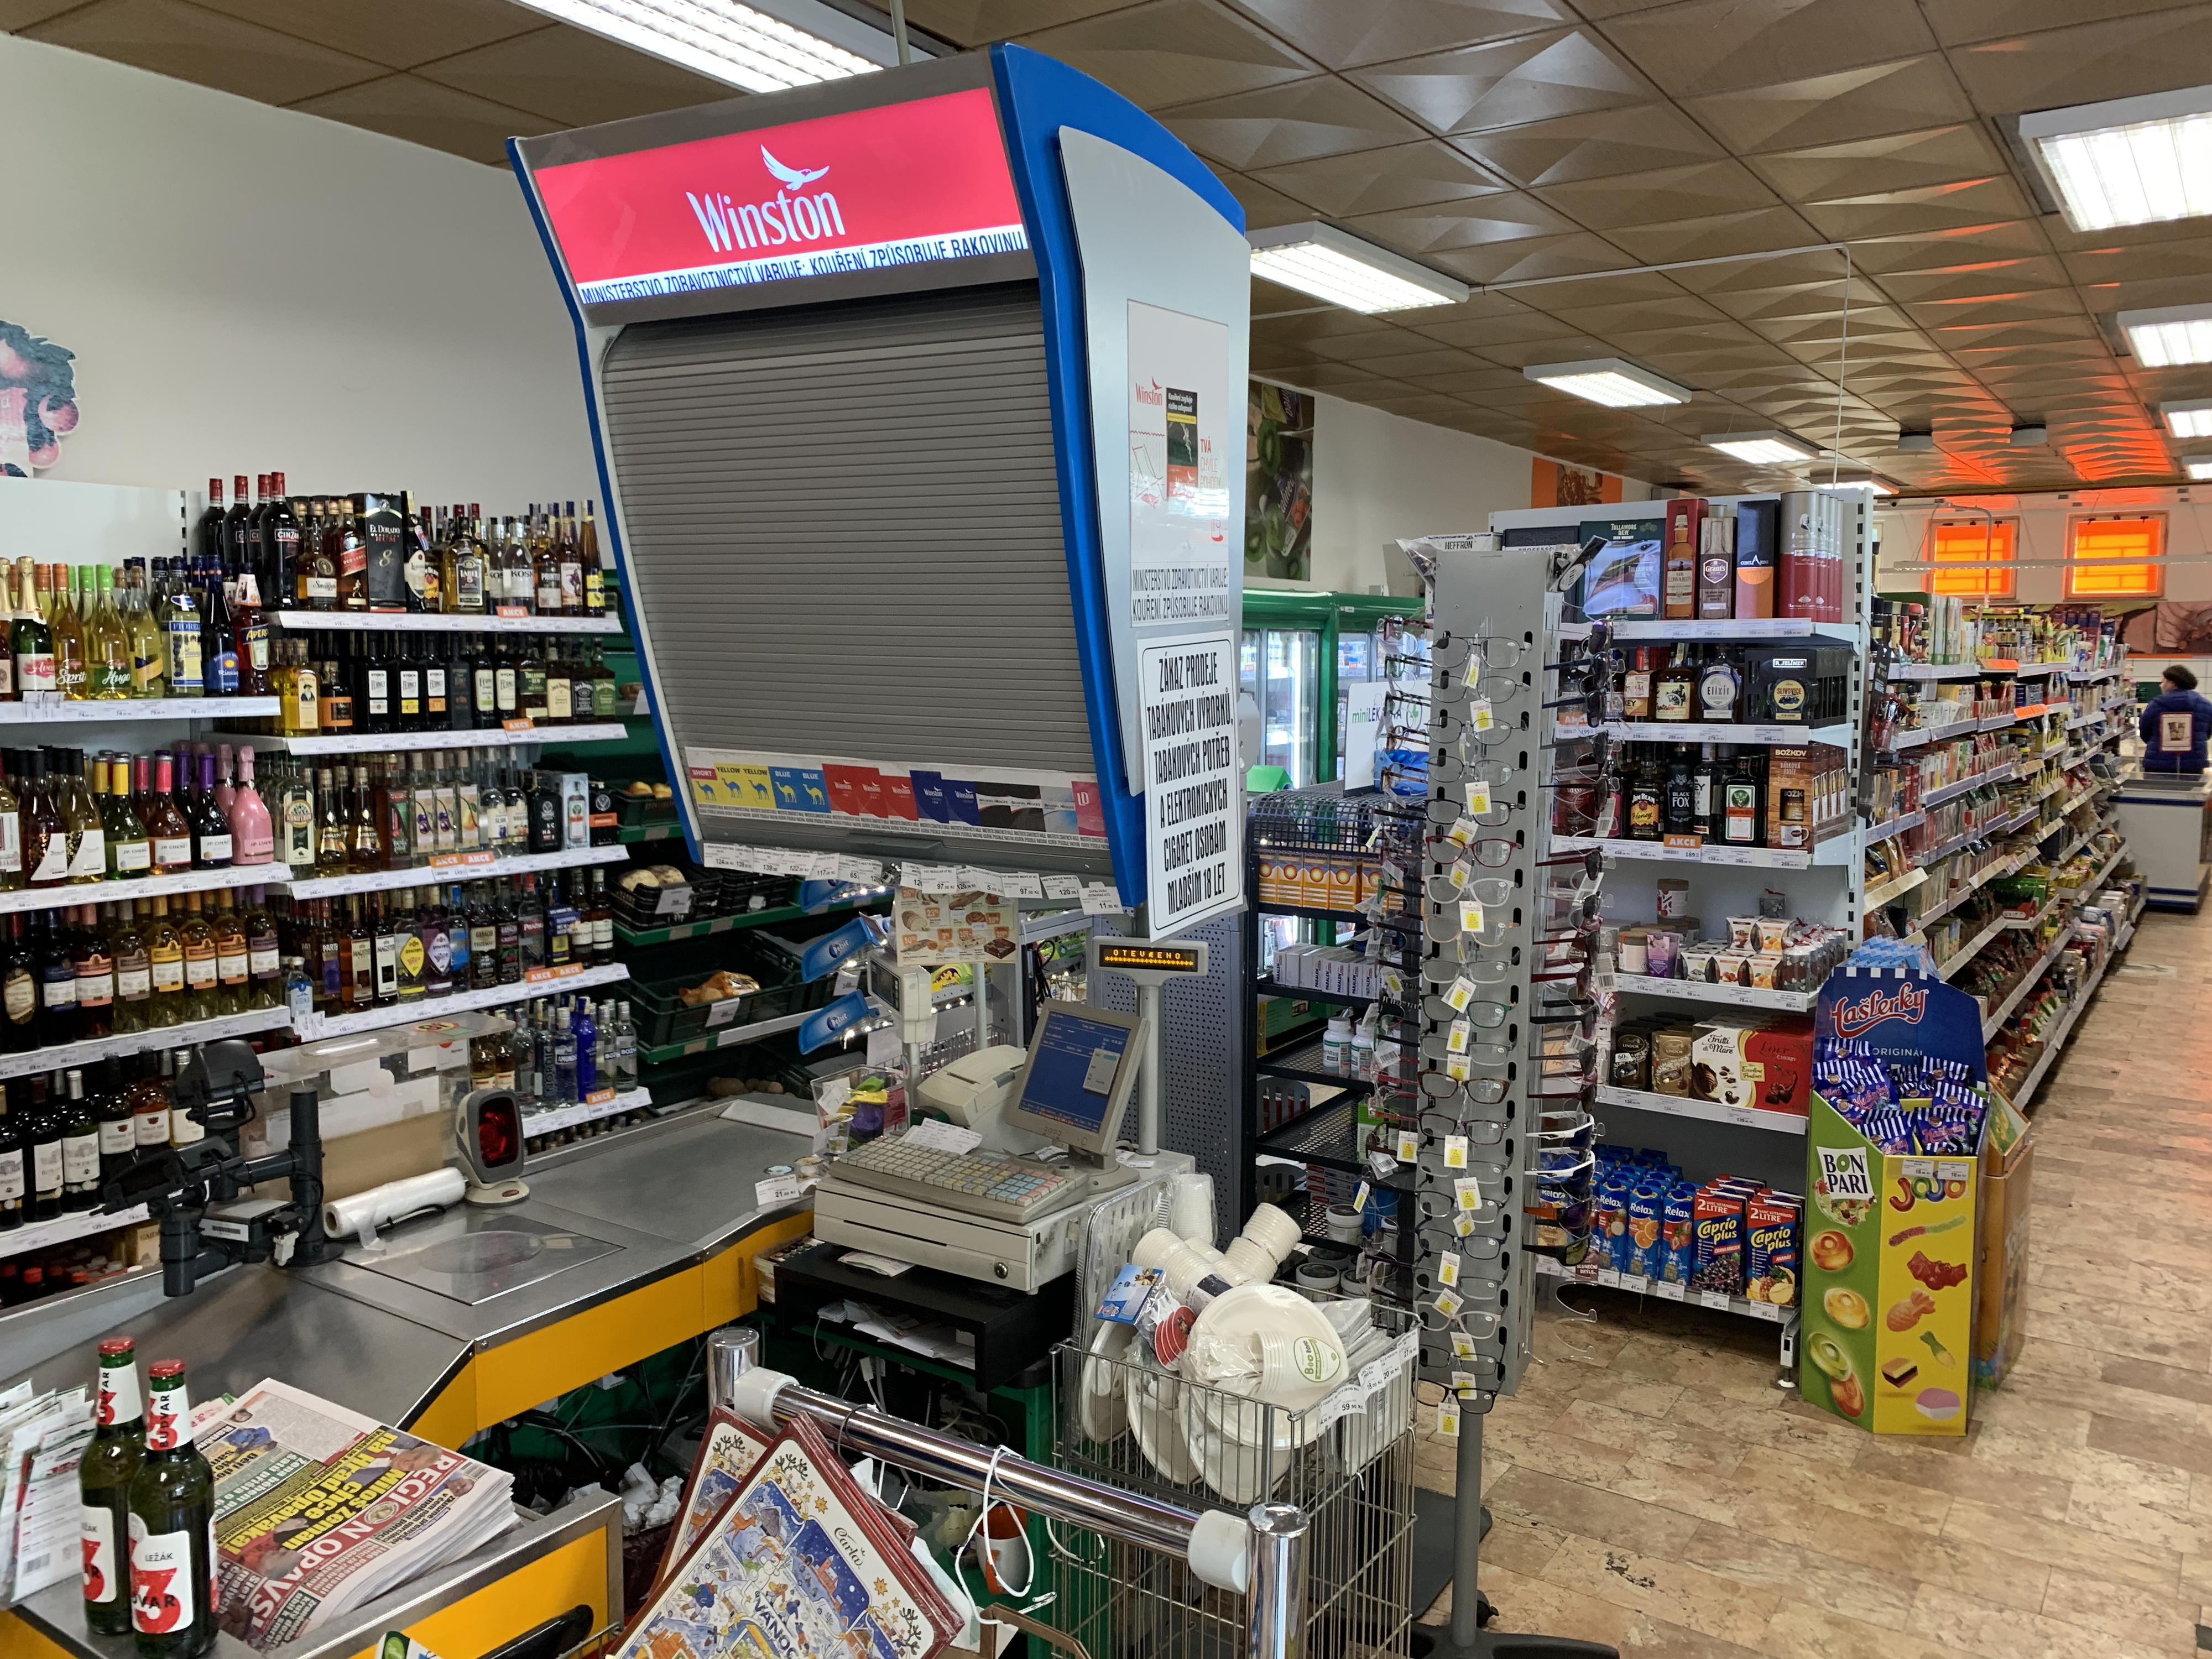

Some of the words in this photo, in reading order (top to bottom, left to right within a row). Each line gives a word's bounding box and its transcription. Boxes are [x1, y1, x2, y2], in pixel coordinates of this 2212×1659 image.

[686, 189, 845, 252] Winston
[581, 278, 662, 304] MINISTERSTVO
[665, 263, 754, 294] ZDRAVOTNICTVÍ
[809, 248, 868, 276] KOUŘENÍ
[869, 241, 947, 268] ZPŮSOBUJE
[951, 232, 1024, 258] RAKOVINU
[1135, 383, 1162, 406] Winston
[1201, 436, 1211, 453] TVÁ
[370, 524, 377, 533] EL
[378, 525, 400, 535] DORADO
[1445, 540, 1473, 550] HEFFRON
[1133, 568, 1171, 591] MINISTERSTVO
[1171, 564, 1209, 589] ZDRAVOTNICTVÍ
[1133, 593, 1162, 622] KOUŘENÍ
[1163, 592, 1198, 619] ZPŮSOBUJE
[1199, 594, 1228, 616] RAKOVINU
[102, 671, 131, 685] Hugo
[1159, 652, 1183, 692] ZÁKAZ
[1186, 652, 1218, 688] PRODEJE
[1707, 684, 1729, 695] Elixír
[1147, 695, 1194, 741] TABÁKOVÝCH
[1196, 687, 1233, 728] VÝROBKŮ,
[1154, 738, 1200, 785] TABÁKOVÝCH
[1203, 731, 1230, 769] POTŘEB
[692, 769, 712, 777] SHORT
[833, 781, 852, 790] Winston
[862, 784, 881, 792] Winston
[891, 785, 911, 795] Winston
[924, 788, 943, 797] Winston
[954, 790, 974, 800] Winston
[1160, 795, 1165, 829] A
[1167, 775, 1228, 824] ELEKTRONICKÝCH
[1672, 797, 1689, 807] FOX
[1632, 812, 1652, 820] Honey
[1164, 827, 1193, 872] CIGARET
[1195, 816, 1227, 860] OSOBÁM
[1669, 837, 1695, 847] AKCE
[436, 857, 458, 865] AKCE
[468, 854, 491, 863] AKCE
[1167, 869, 1202, 916] MLADŠÍM
[1203, 868, 1212, 899] 18
[1214, 862, 1225, 895] LET
[531, 971, 552, 981] AKCE
[560, 967, 580, 975] AKCE
[1708, 1034, 1730, 1045] Frutti
[1709, 1043, 1734, 1055] Mare
[592, 1092, 611, 1102] AKCE
[1824, 1154, 1865, 1173] BON
[1826, 1173, 1868, 1194] PARI
[1600, 1194, 1623, 1208] Relax
[1630, 1203, 1654, 1215] Relax
[1697, 1199, 1707, 1211] 2
[1707, 1204, 1728, 1214] LITRE
[1665, 1206, 1691, 1218] Relax
[1750, 1208, 1759, 1219] 2
[1759, 1213, 1781, 1223] LITRE
[1697, 1218, 1737, 1239] Caprio
[1714, 1229, 1737, 1245] plus
[1751, 1226, 1791, 1248] Caprio
[1767, 1239, 1792, 1254] plus
[159, 1394, 170, 1448] BUDVAR
[367, 1432, 398, 1455] na
[268, 1452, 297, 1473] šatů
[276, 1457, 307, 1478] Žena
[319, 1452, 375, 1493] Hrad
[233, 1470, 270, 1495] přišla
[349, 1468, 406, 1512] Miloš
[303, 1480, 363, 1521] chce
[405, 1496, 434, 1521] mohou
[223, 1488, 327, 1557] Opaváka!
[281, 1505, 354, 1552] Zeman
[834, 1527, 864, 1568] Carla
[144, 1552, 174, 1562] LEŽÁK
[246, 1535, 343, 1629] OPAVS
[754, 1598, 800, 1659] VÁNOC
